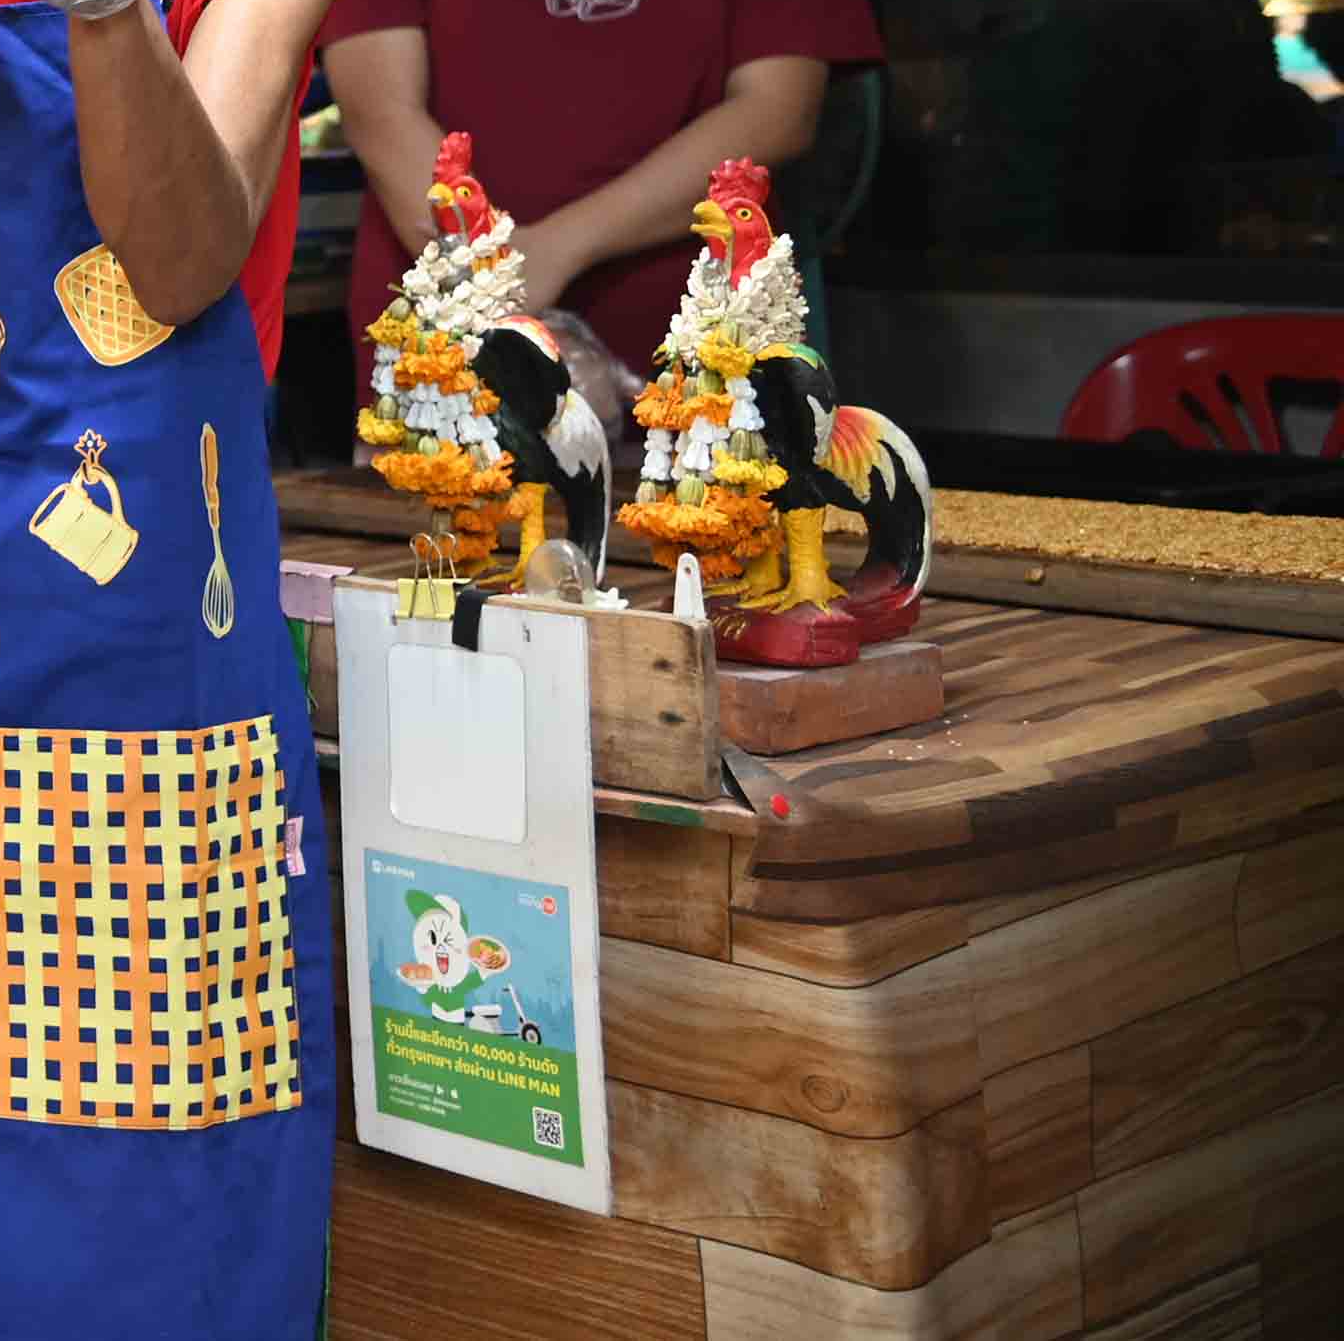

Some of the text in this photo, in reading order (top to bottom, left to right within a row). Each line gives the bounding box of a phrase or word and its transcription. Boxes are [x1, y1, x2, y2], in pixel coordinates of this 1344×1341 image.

[472, 1043, 516, 1066] 40,000
[497, 1070, 527, 1090] LINE
[528, 1076, 561, 1098] MAN
